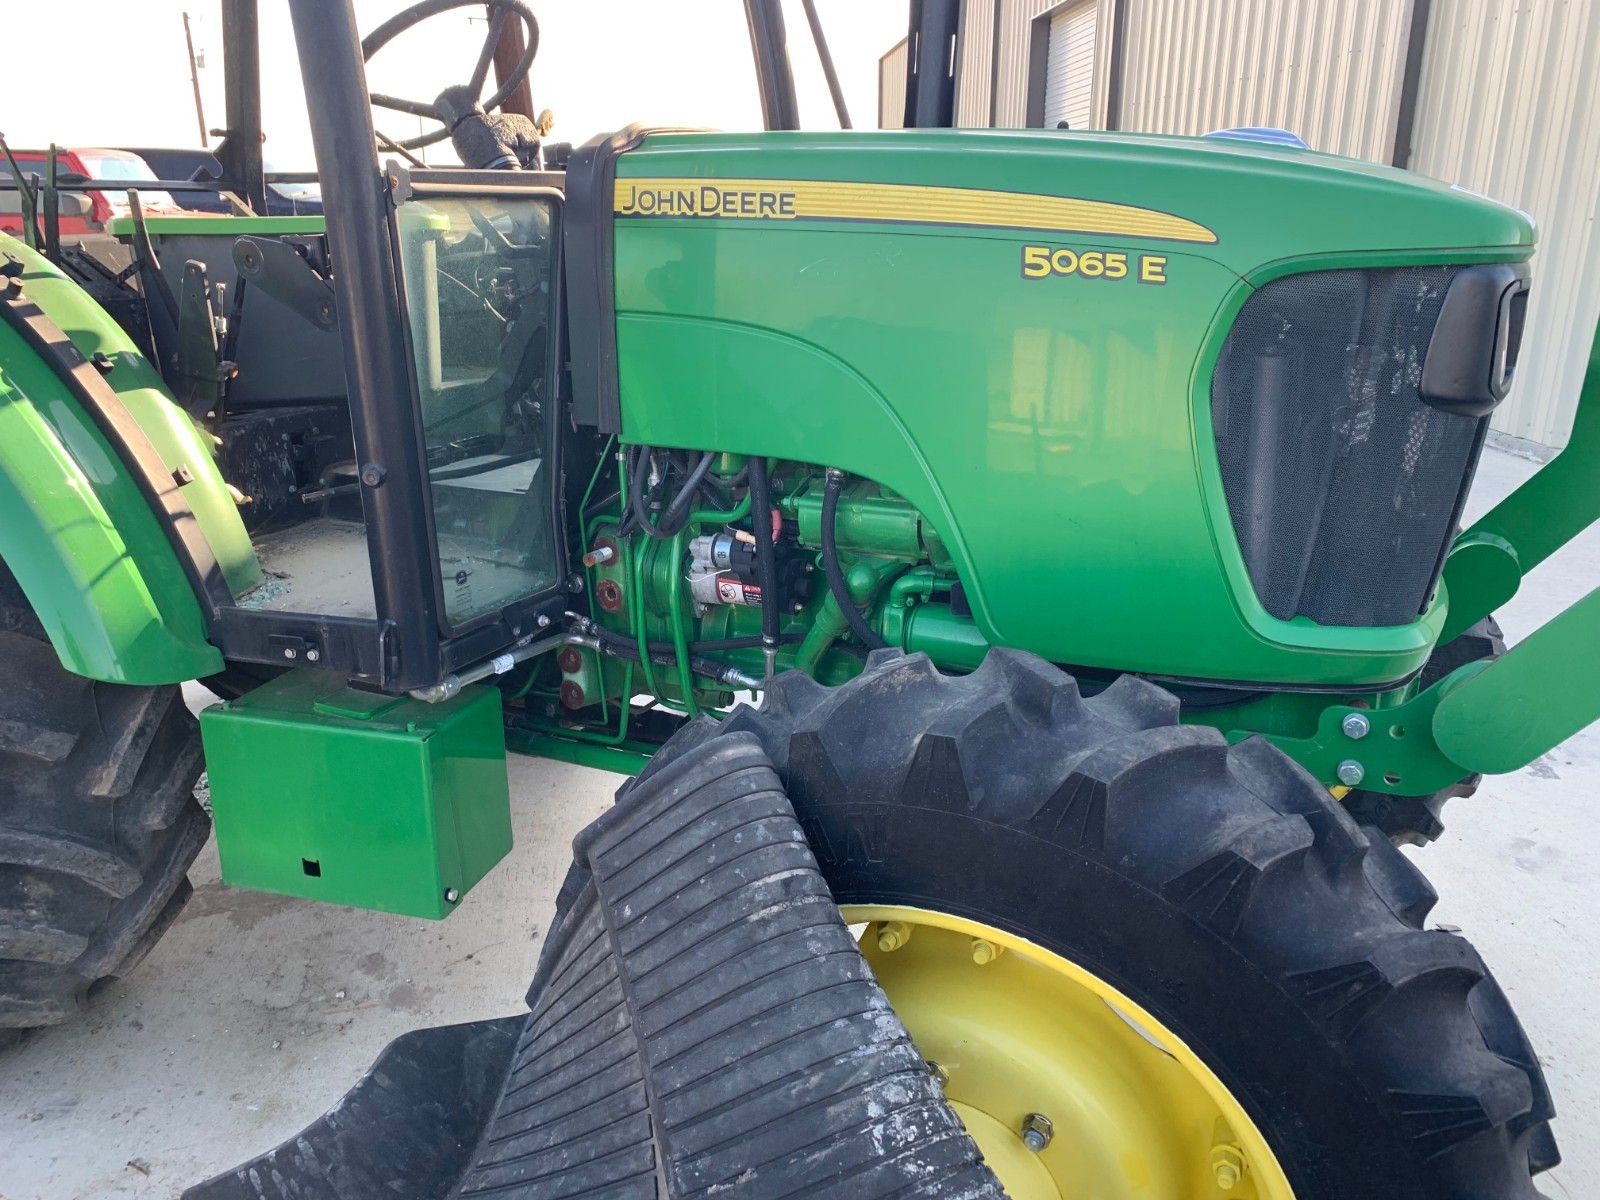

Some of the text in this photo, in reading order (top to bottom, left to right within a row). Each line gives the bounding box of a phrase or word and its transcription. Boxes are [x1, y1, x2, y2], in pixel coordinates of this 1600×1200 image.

[622, 185, 796, 215] JOHN DEERE
[1022, 245, 1167, 285] 5065 E
